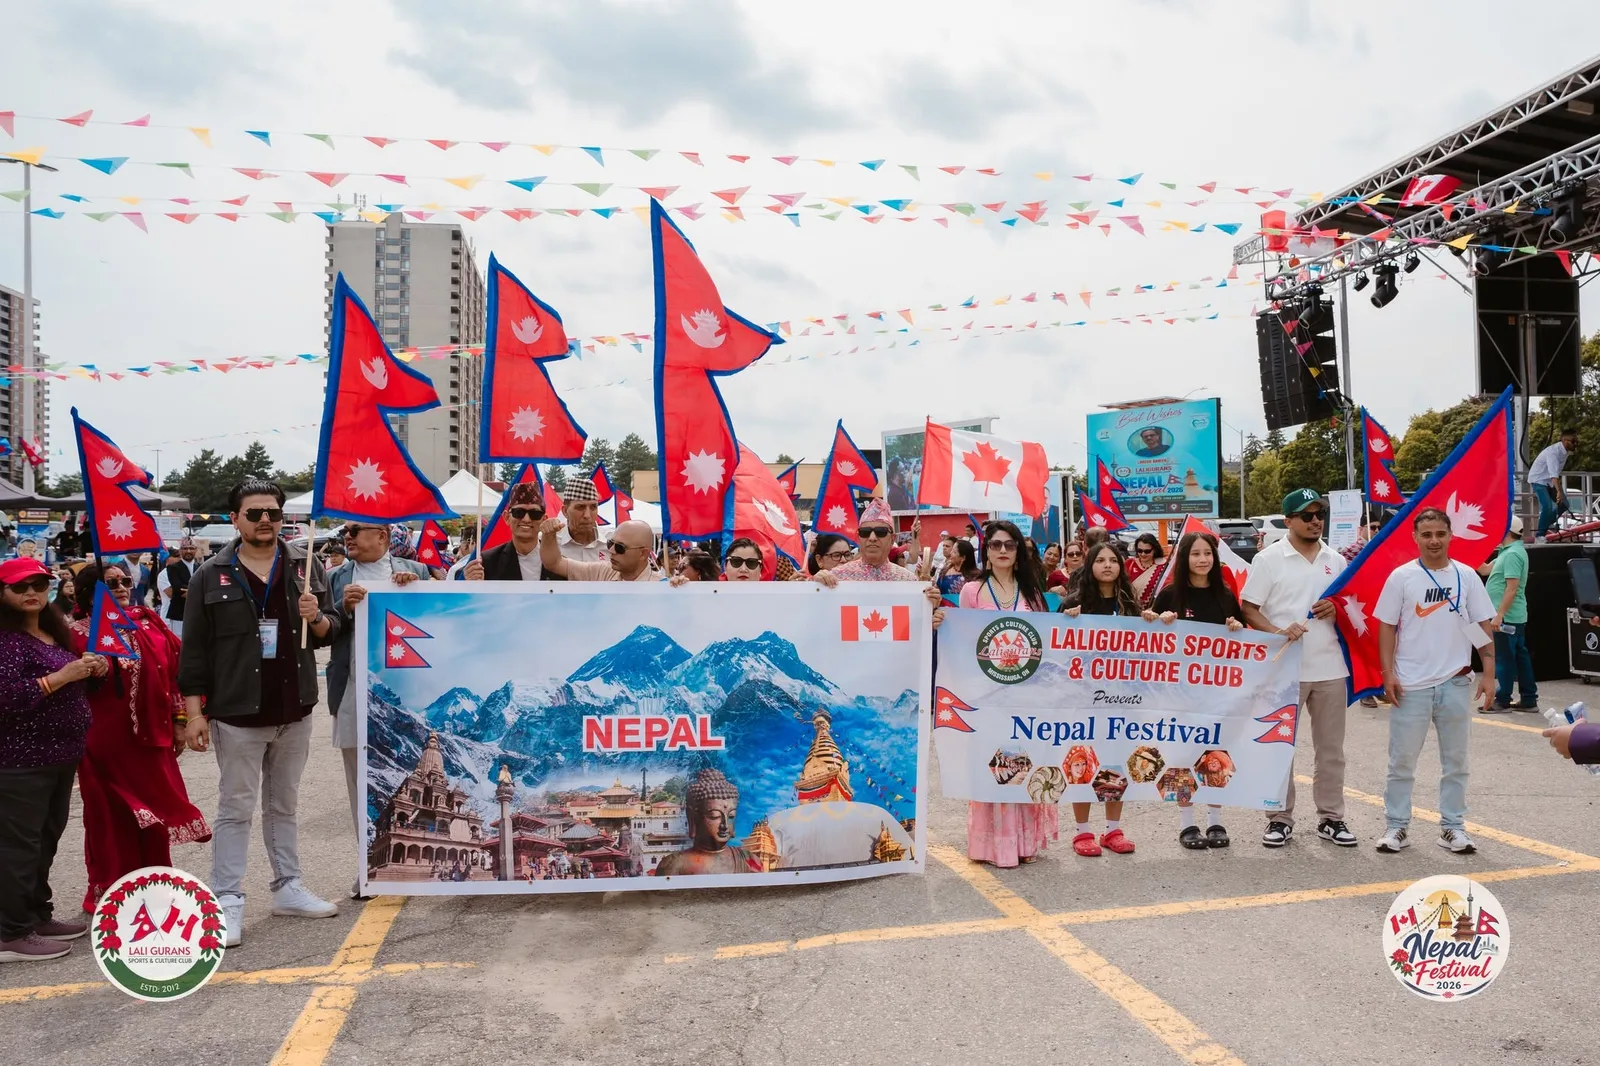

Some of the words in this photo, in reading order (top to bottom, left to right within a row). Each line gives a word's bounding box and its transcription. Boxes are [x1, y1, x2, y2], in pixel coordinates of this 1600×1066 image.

[1146, 408, 1182, 423] Wishes
[1424, 587, 1452, 603] NIKE
[983, 625, 999, 643] SPORTS
[1006, 621, 1029, 633] CULTURE
[1028, 632, 1038, 645] CLUB
[1050, 627, 1176, 654] LALIGURANS
[1183, 634, 1268, 662] SPORTS
[1068, 657, 1084, 680] &
[1090, 658, 1181, 683] CULTURE
[1187, 662, 1244, 688] CLUB
[1093, 690, 1144, 705] Presents
[584, 714, 725, 751] NEPAL
[1010, 715, 1095, 746] Nepal
[1106, 716, 1222, 745] Festival
